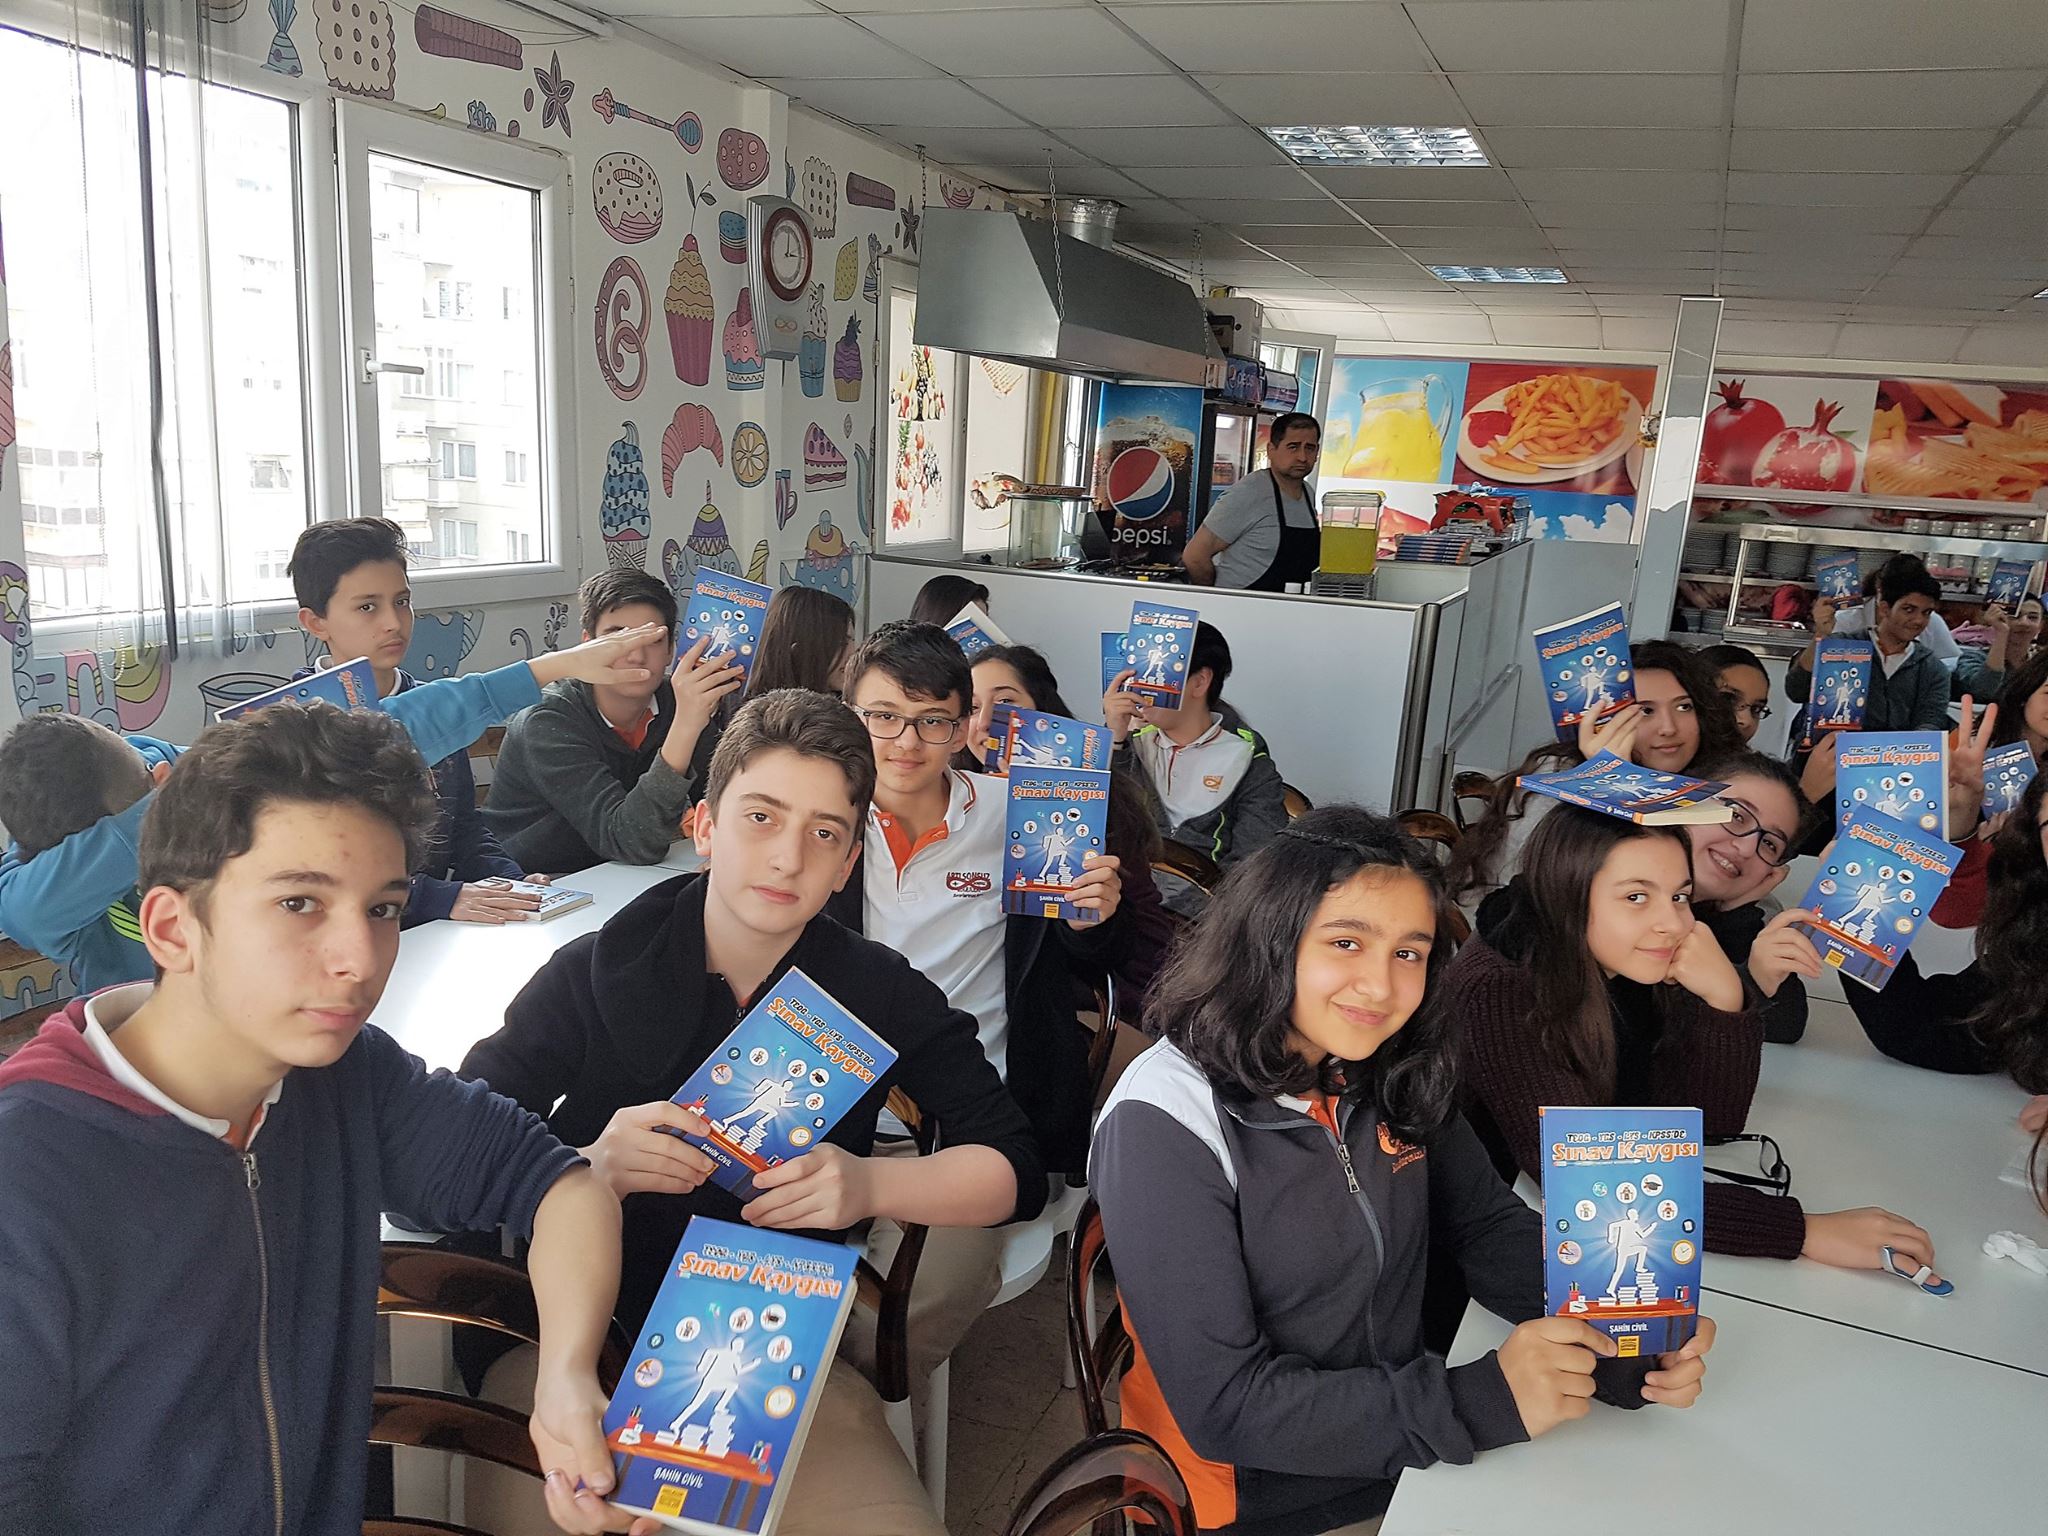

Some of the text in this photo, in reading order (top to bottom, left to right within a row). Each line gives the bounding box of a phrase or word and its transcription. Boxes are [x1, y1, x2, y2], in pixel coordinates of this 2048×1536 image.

[1013, 785, 1106, 802] Sınav Kaygısı
[1850, 824, 1952, 876] Sınav Kaygısı
[768, 997, 876, 1084] Sınav Kaygısı
[1552, 1141, 1699, 1163] Sınav Kaygısı
[679, 1252, 748, 1282] Sınav
[749, 1264, 842, 1299] Kaygısı
